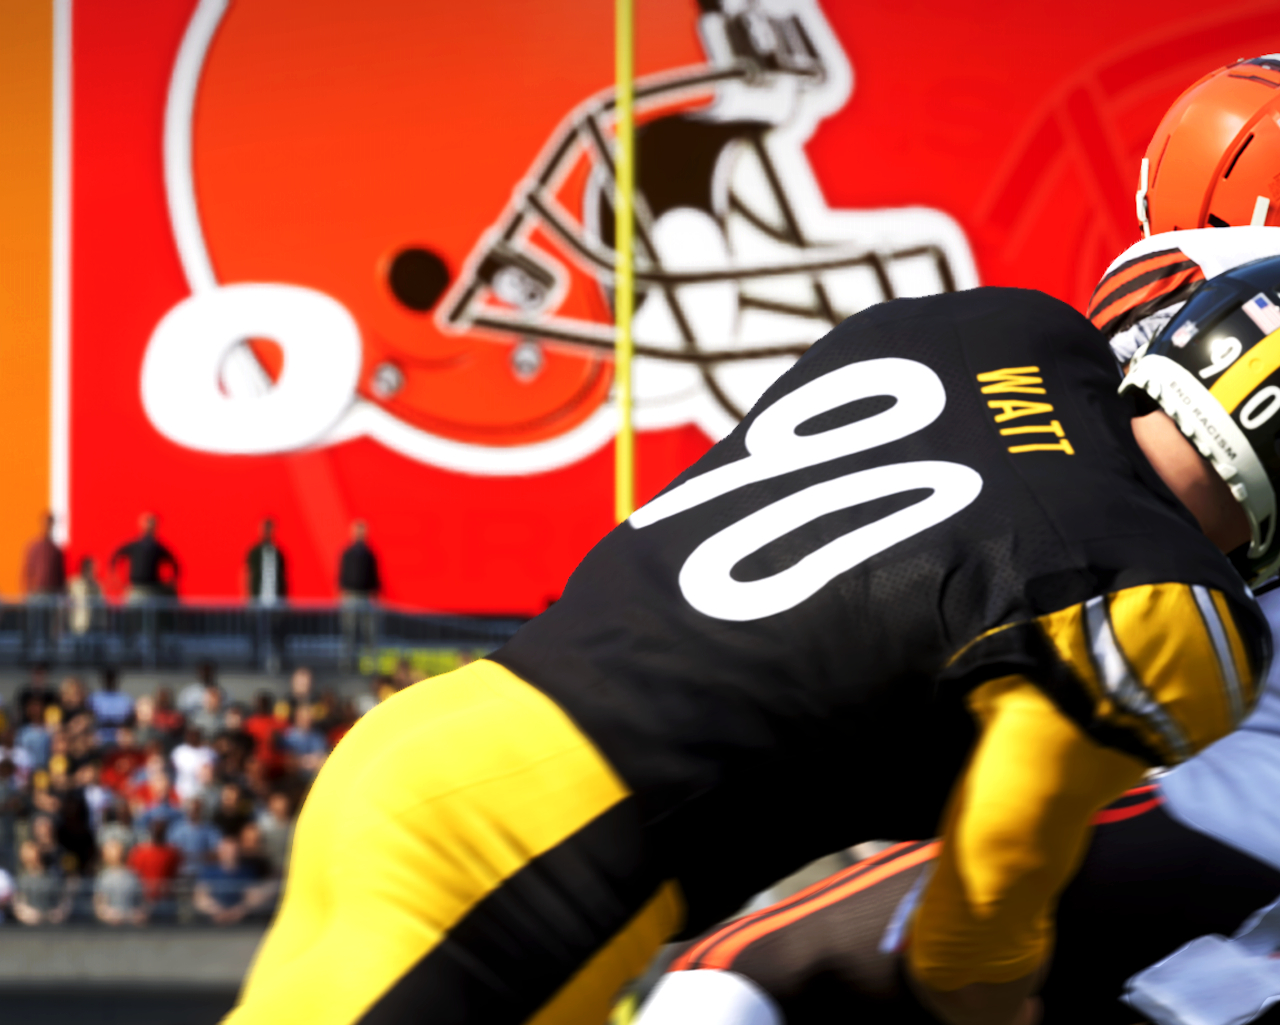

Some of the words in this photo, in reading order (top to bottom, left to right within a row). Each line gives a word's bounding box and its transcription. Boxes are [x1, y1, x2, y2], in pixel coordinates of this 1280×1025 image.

[976, 365, 1076, 456] WATT
[1192, 407, 1238, 462] RACISM
[628, 357, 984, 622] 90
